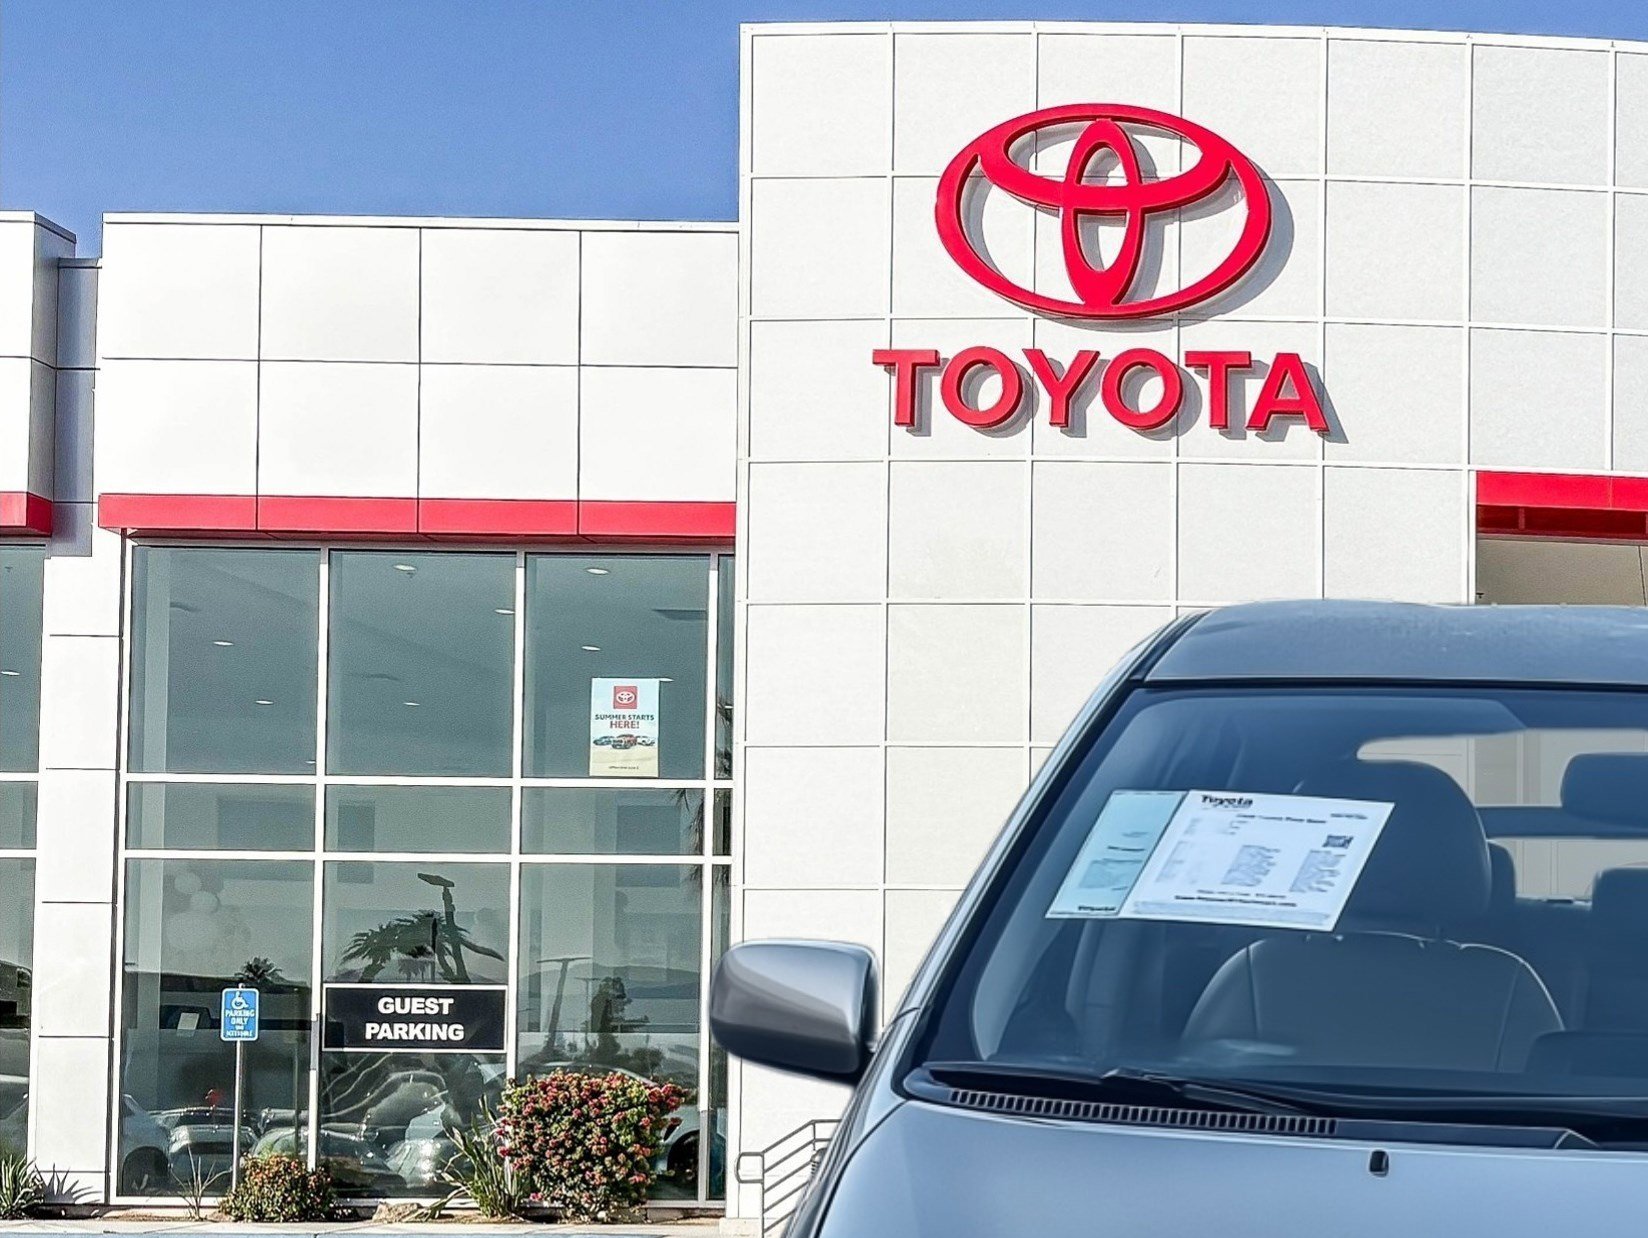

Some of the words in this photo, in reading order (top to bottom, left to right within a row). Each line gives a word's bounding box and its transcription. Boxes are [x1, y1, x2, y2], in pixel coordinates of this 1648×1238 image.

[872, 346, 1330, 432] TOYOTA
[610, 720, 640, 729] HERE!
[225, 1009, 255, 1017] PARKING
[378, 997, 454, 1014] GUEST
[365, 1023, 465, 1041] PARKING
